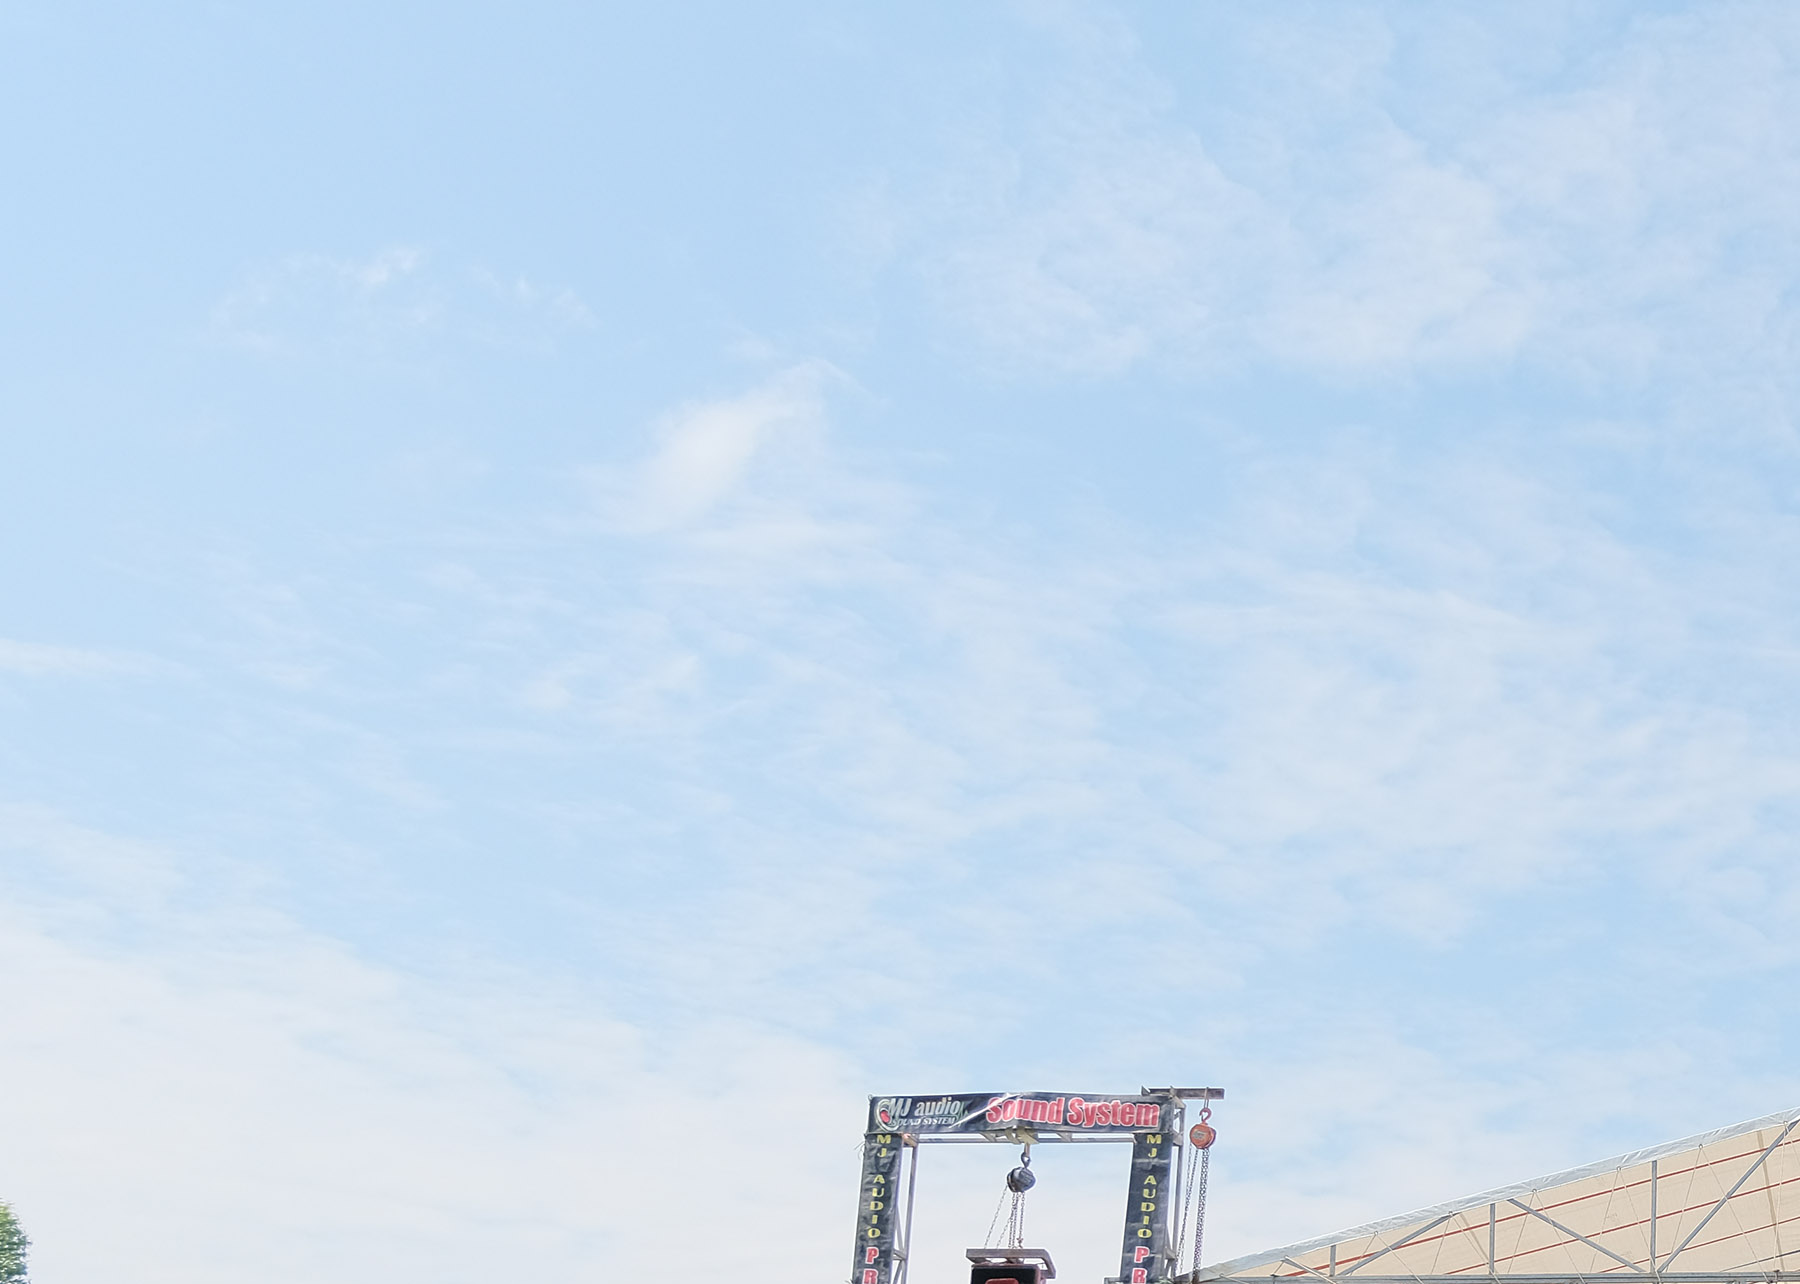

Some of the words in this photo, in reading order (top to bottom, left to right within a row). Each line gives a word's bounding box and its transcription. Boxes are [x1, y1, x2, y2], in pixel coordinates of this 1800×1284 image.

[914, 1097, 961, 1116] audio
[922, 1116, 956, 1125] SYSTEM
[986, 1094, 1068, 1125] Sound
[1066, 1097, 1160, 1128] System
[866, 1174, 886, 1239] AUDIO
[1137, 1174, 1158, 1239] AUDIO
